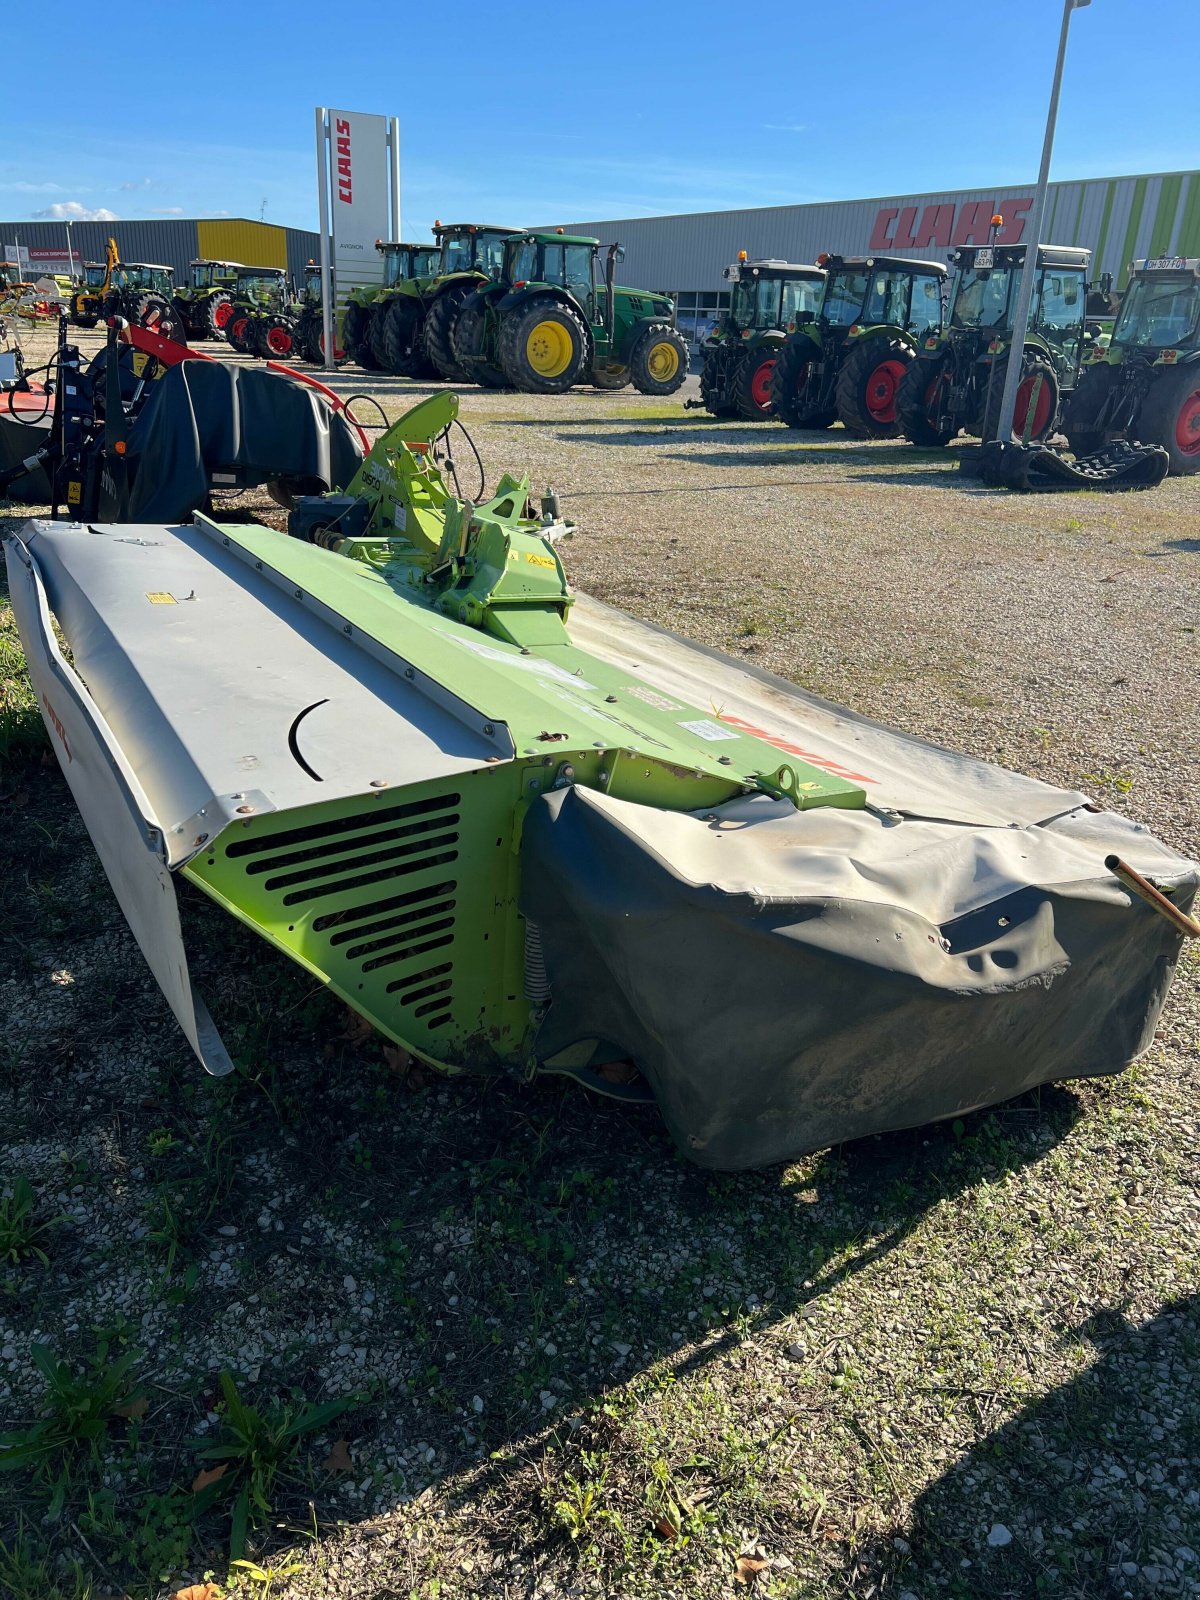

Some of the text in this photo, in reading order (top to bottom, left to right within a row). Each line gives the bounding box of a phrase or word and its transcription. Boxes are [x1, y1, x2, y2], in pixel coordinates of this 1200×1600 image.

[337, 118, 352, 205] CLAAS
[869, 198, 1033, 249] CLAAS
[362, 470, 381, 491] DISCO
